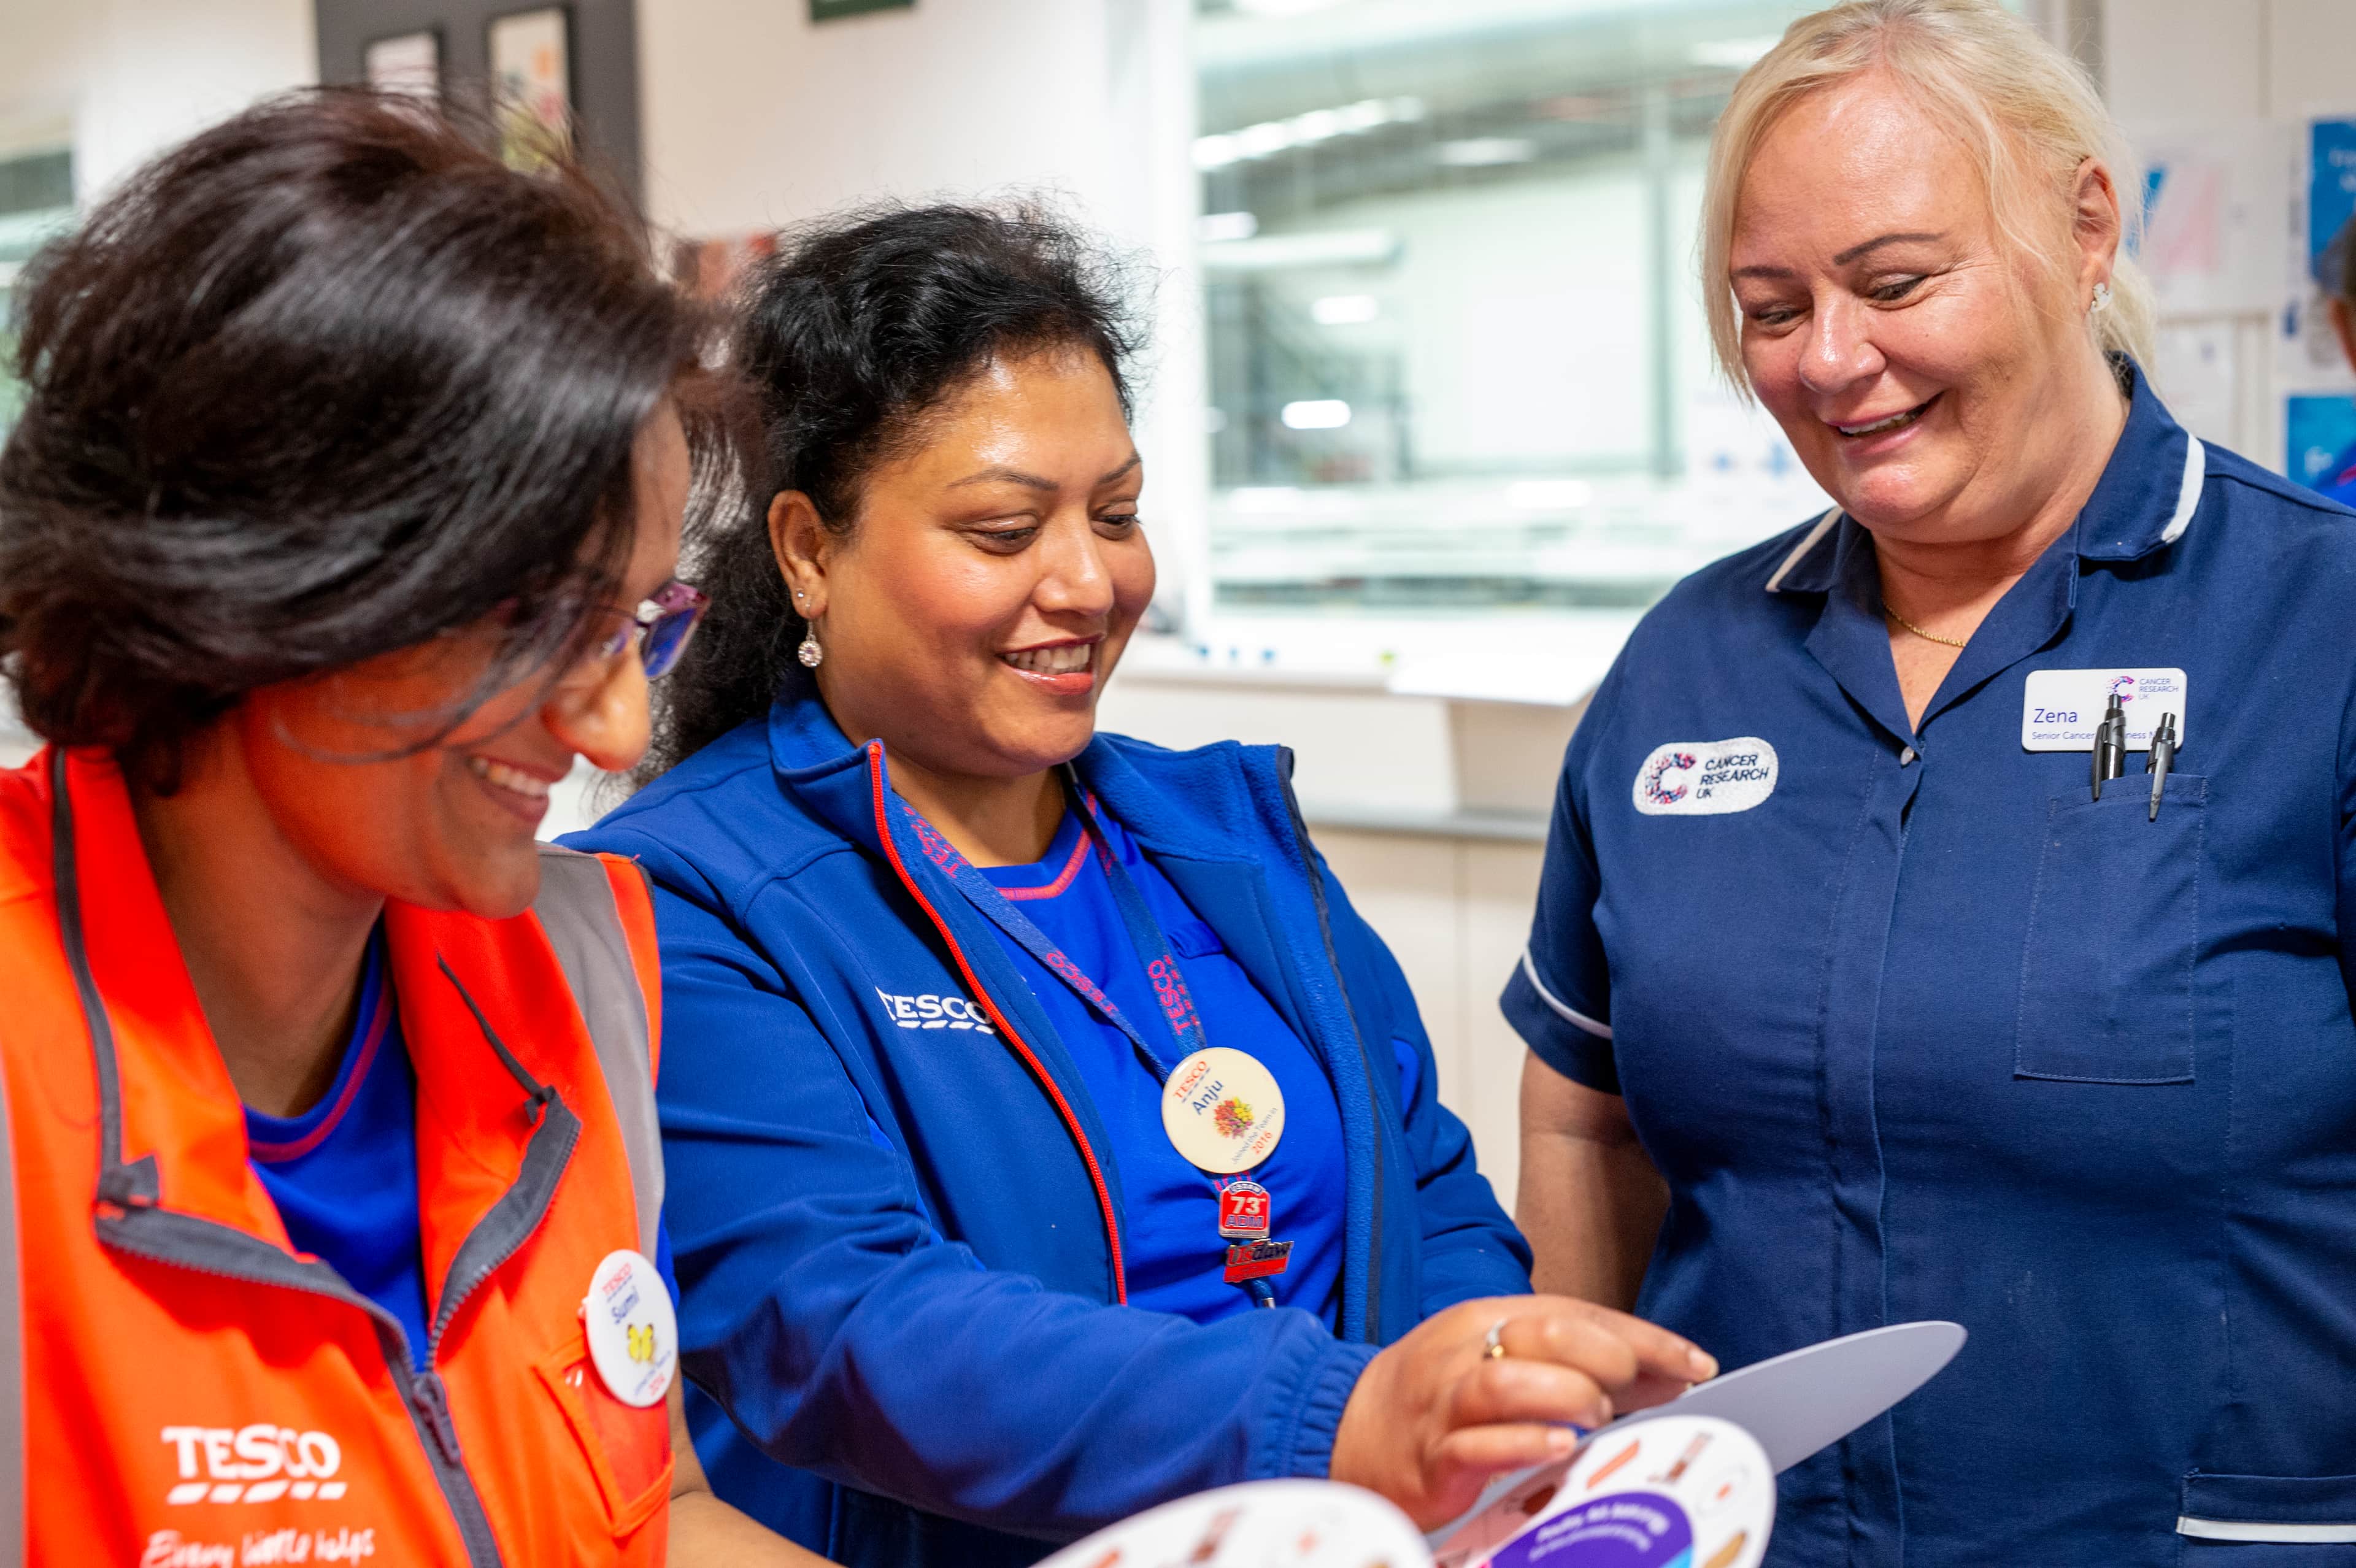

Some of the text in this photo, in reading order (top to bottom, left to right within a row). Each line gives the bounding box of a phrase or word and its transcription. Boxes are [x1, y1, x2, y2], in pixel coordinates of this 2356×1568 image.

[2033, 709, 2077, 723] Zena
[1700, 767, 1770, 785] RESEARCH
[1705, 755, 1758, 771] CANCER
[1696, 788, 1713, 799] UK
[1046, 951, 1120, 1016] TESCO
[1147, 959, 1192, 1036] TESCO
[875, 986, 993, 1024] TESCO
[1173, 1061, 1208, 1099] TESCO
[1191, 1080, 1224, 1116] Anju
[1251, 1131, 1272, 1155] 2016
[160, 1423, 341, 1480] TESCO
